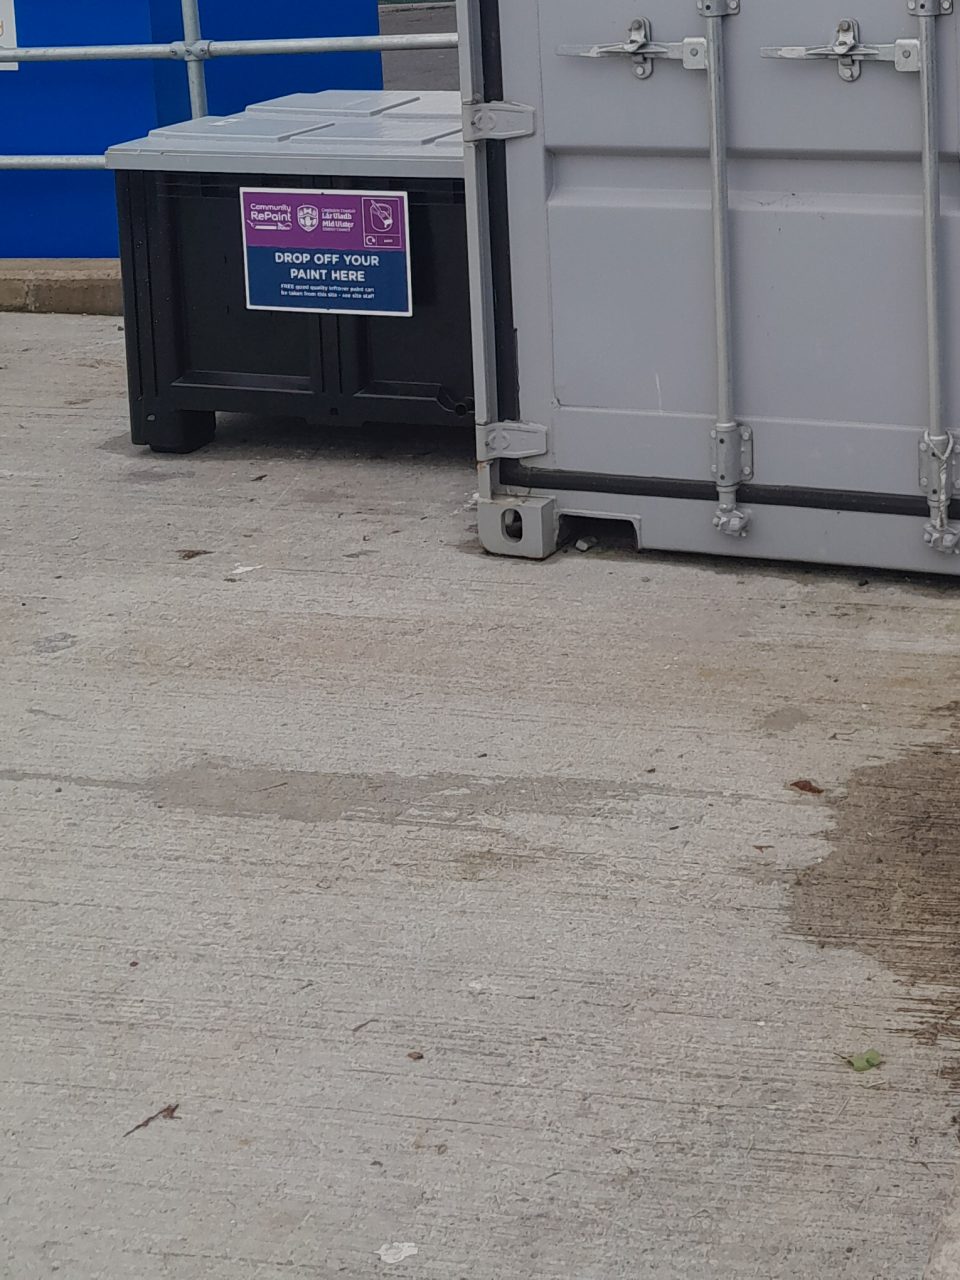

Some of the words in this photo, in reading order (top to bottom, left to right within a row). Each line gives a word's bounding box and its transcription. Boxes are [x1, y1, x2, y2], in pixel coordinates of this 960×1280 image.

[250, 203, 291, 211] Community
[250, 212, 291, 221] RePaint
[275, 252, 310, 264] DROP
[314, 254, 339, 264] OFF
[343, 255, 379, 266] YOUR
[290, 269, 327, 280] PAINT
[332, 270, 365, 281] HERE
